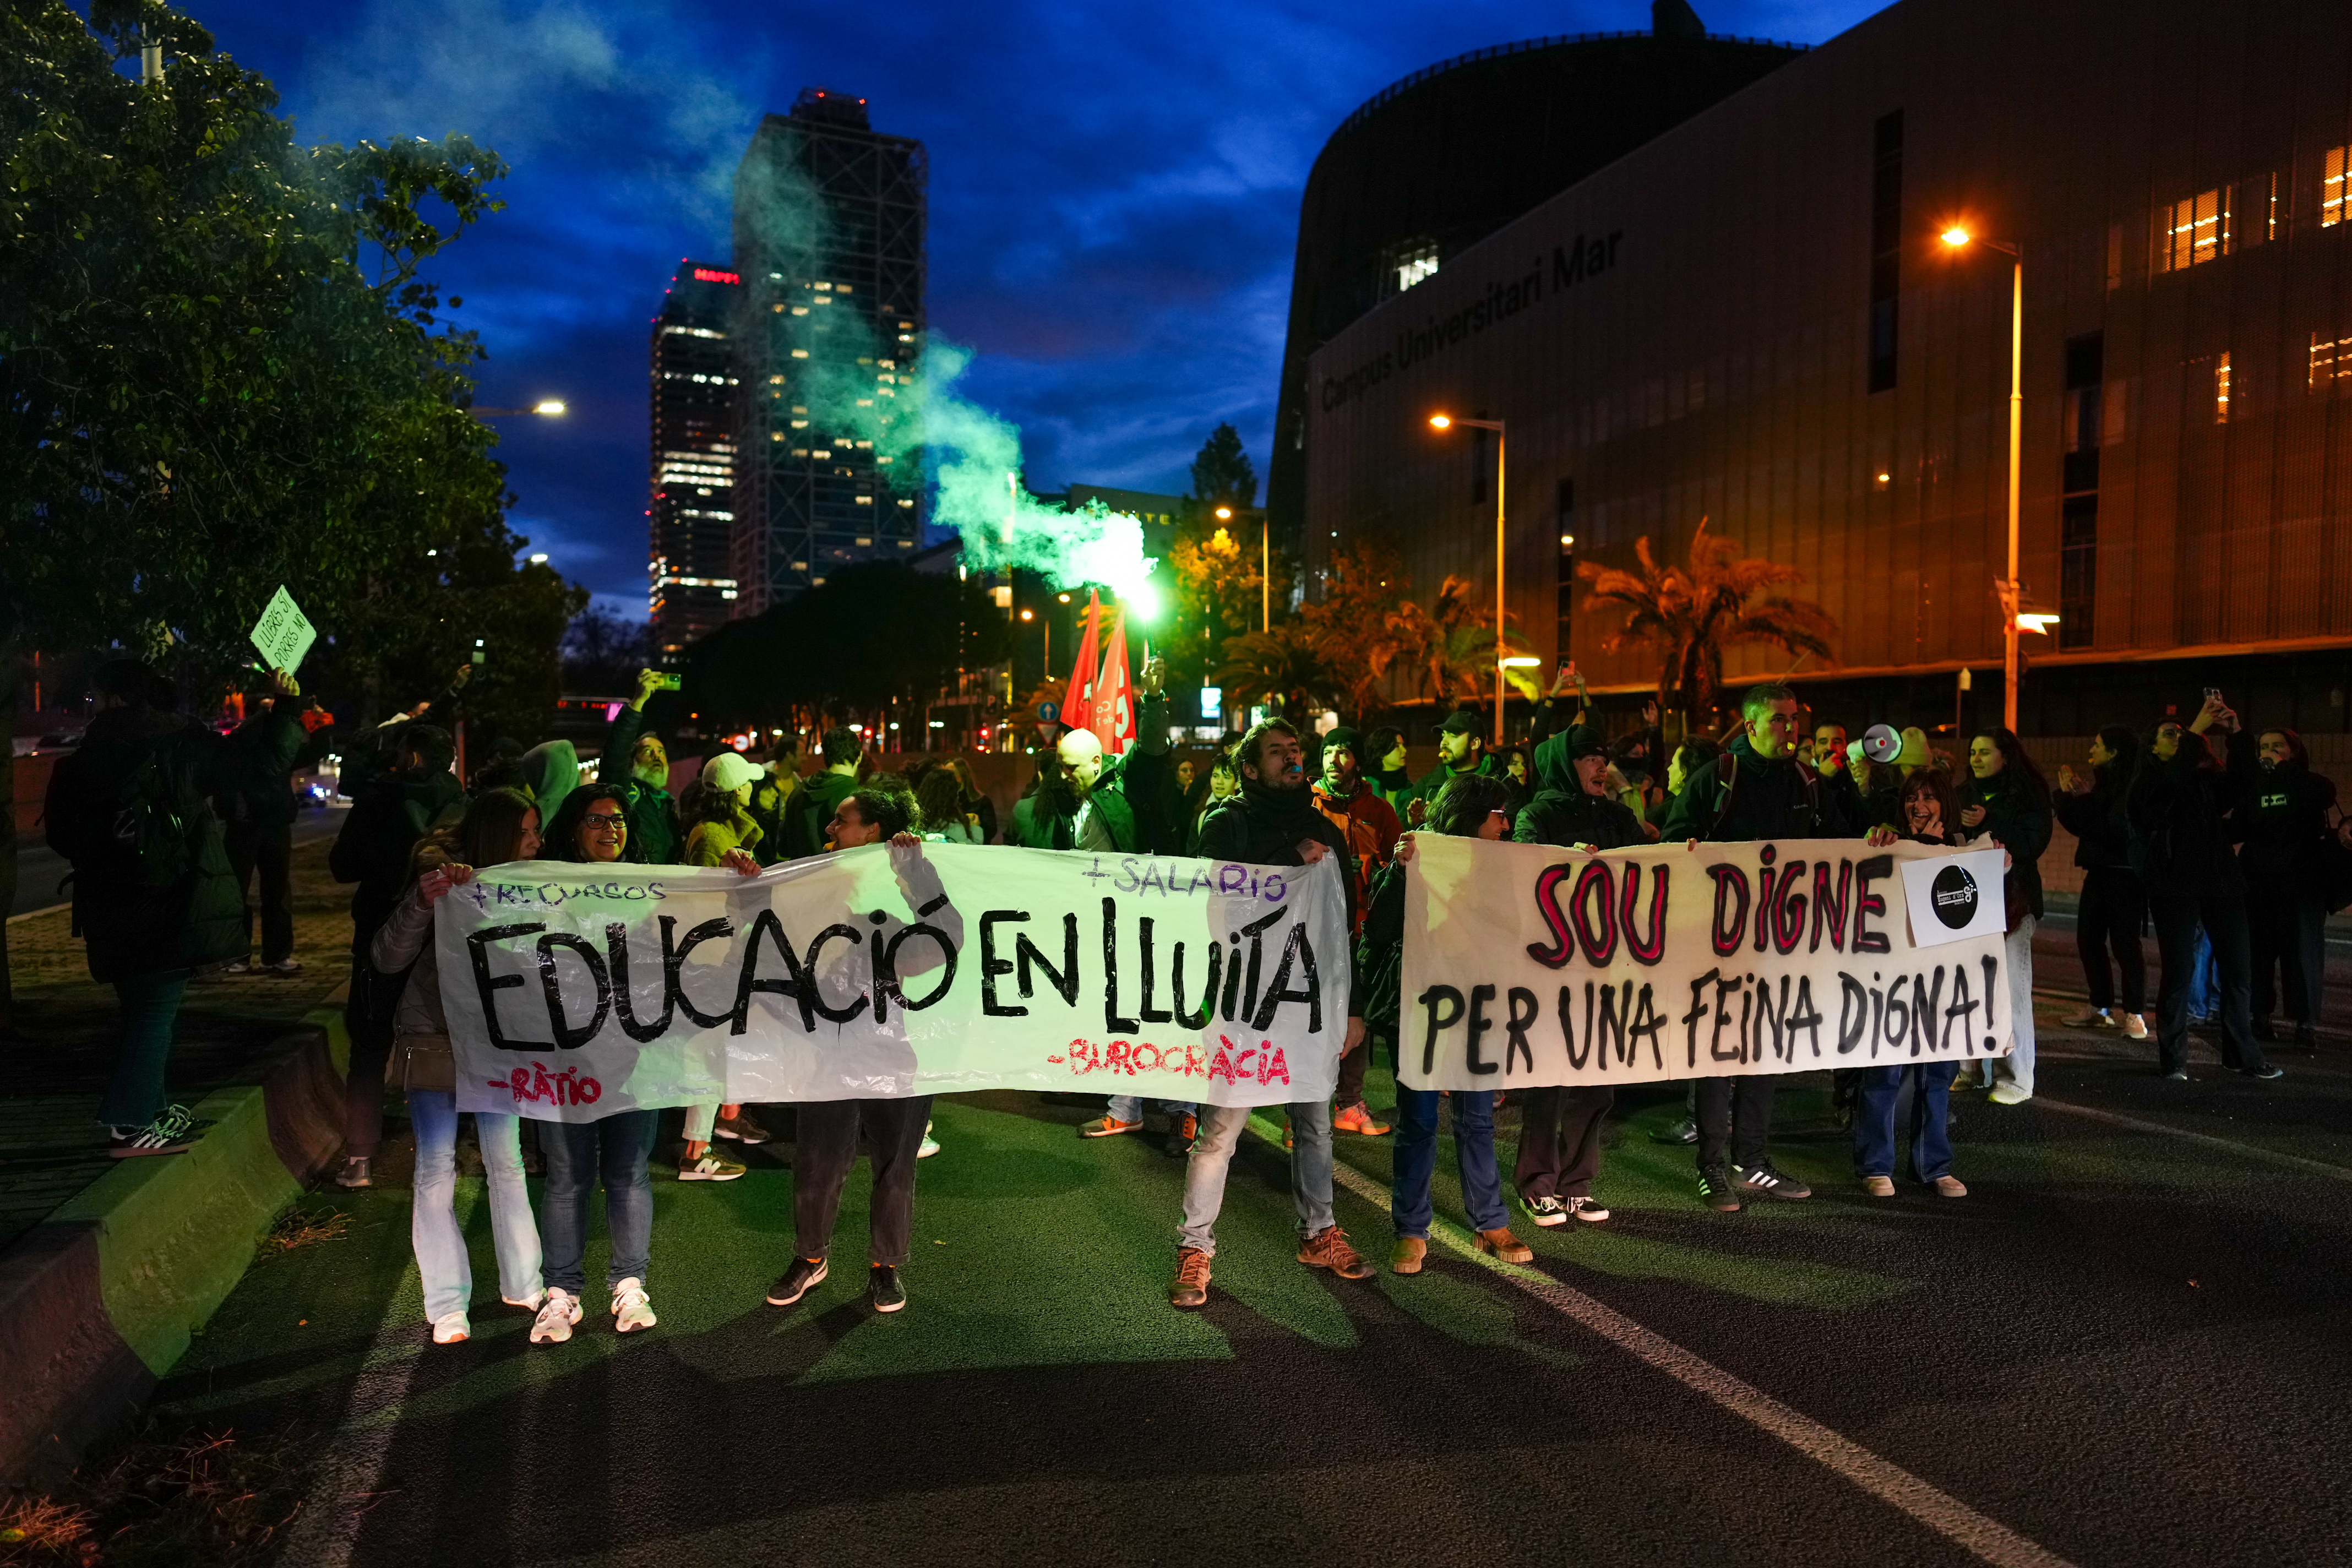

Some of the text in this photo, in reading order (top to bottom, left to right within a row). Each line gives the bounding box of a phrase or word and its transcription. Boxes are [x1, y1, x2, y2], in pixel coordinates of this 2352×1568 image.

[1322, 228, 1623, 412] Campus Universitari Mar
[274, 613, 306, 668] PORRES NO
[1526, 859, 1669, 970] SOU
[1937, 894, 1951, 903] Eugeni
[979, 910, 1080, 1017] EN
[1418, 983, 1539, 1075] PER
[1558, 979, 1668, 1071] UNA
